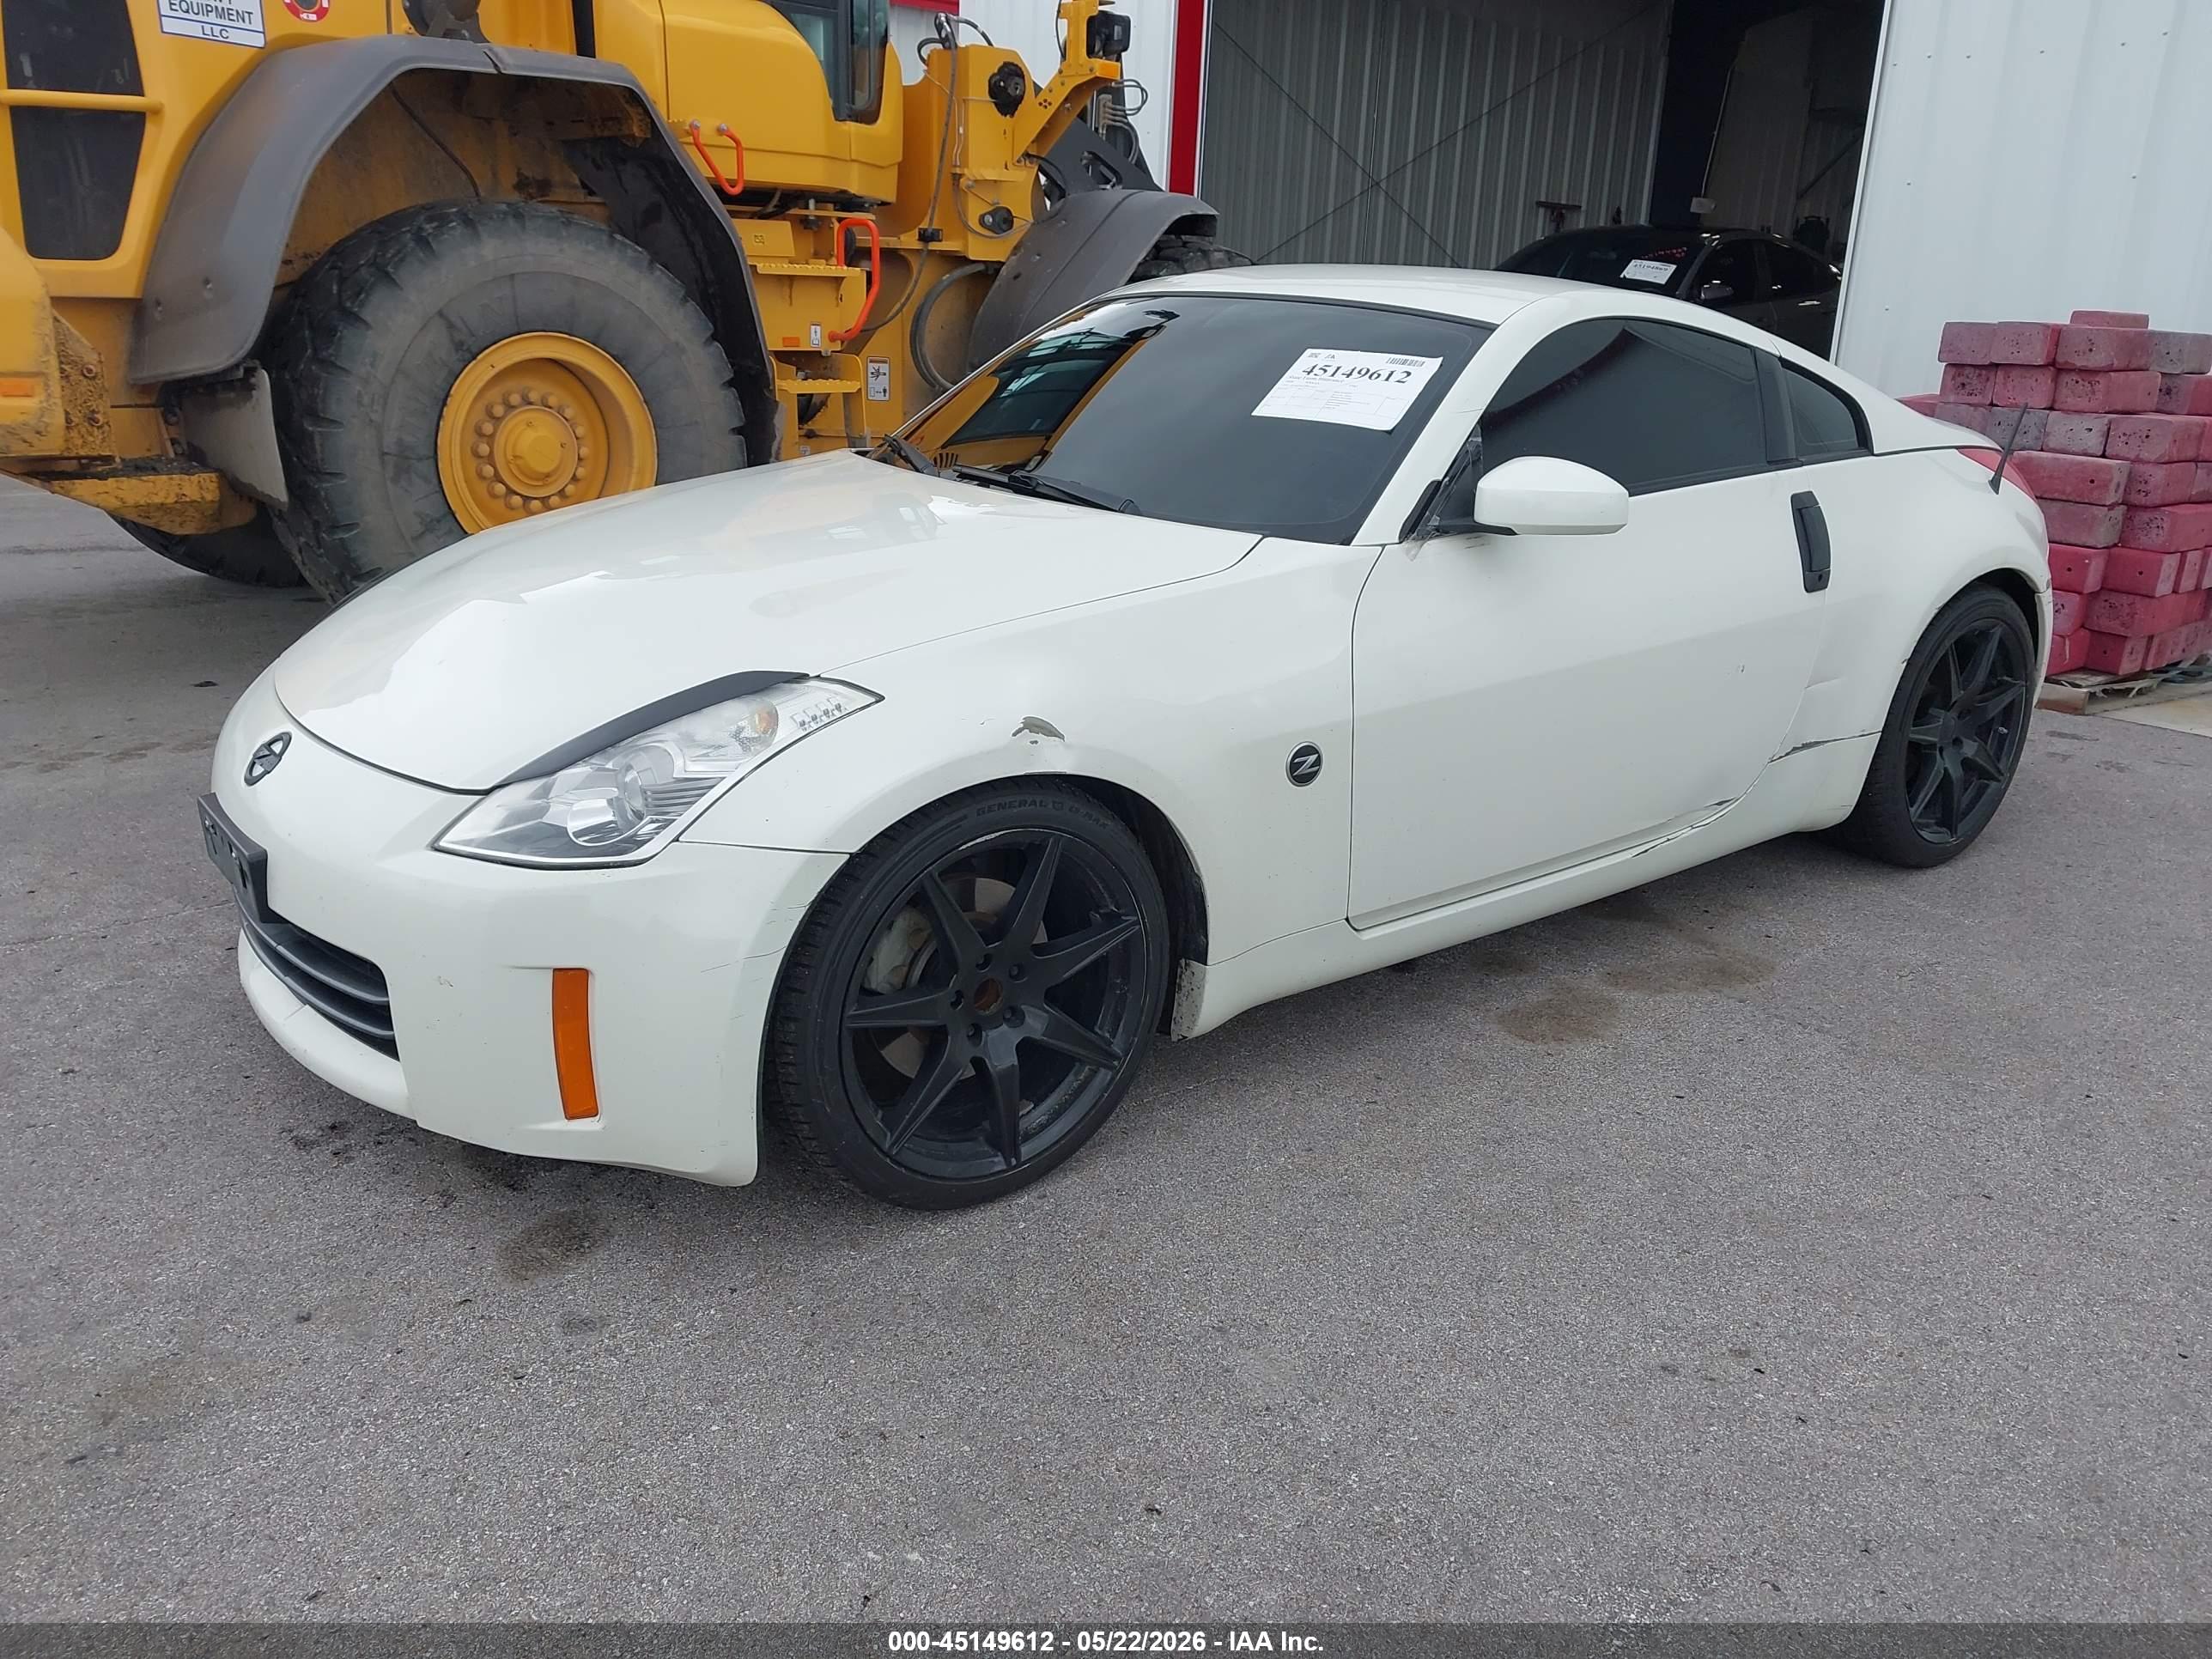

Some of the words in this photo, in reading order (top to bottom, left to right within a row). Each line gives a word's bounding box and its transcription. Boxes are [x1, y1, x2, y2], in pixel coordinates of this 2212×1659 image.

[168, 0, 253, 25] EQUIPMENT
[201, 25, 229, 40] LLC
[1302, 364, 1412, 384] 45149612
[975, 799, 1048, 817] GENERAL
